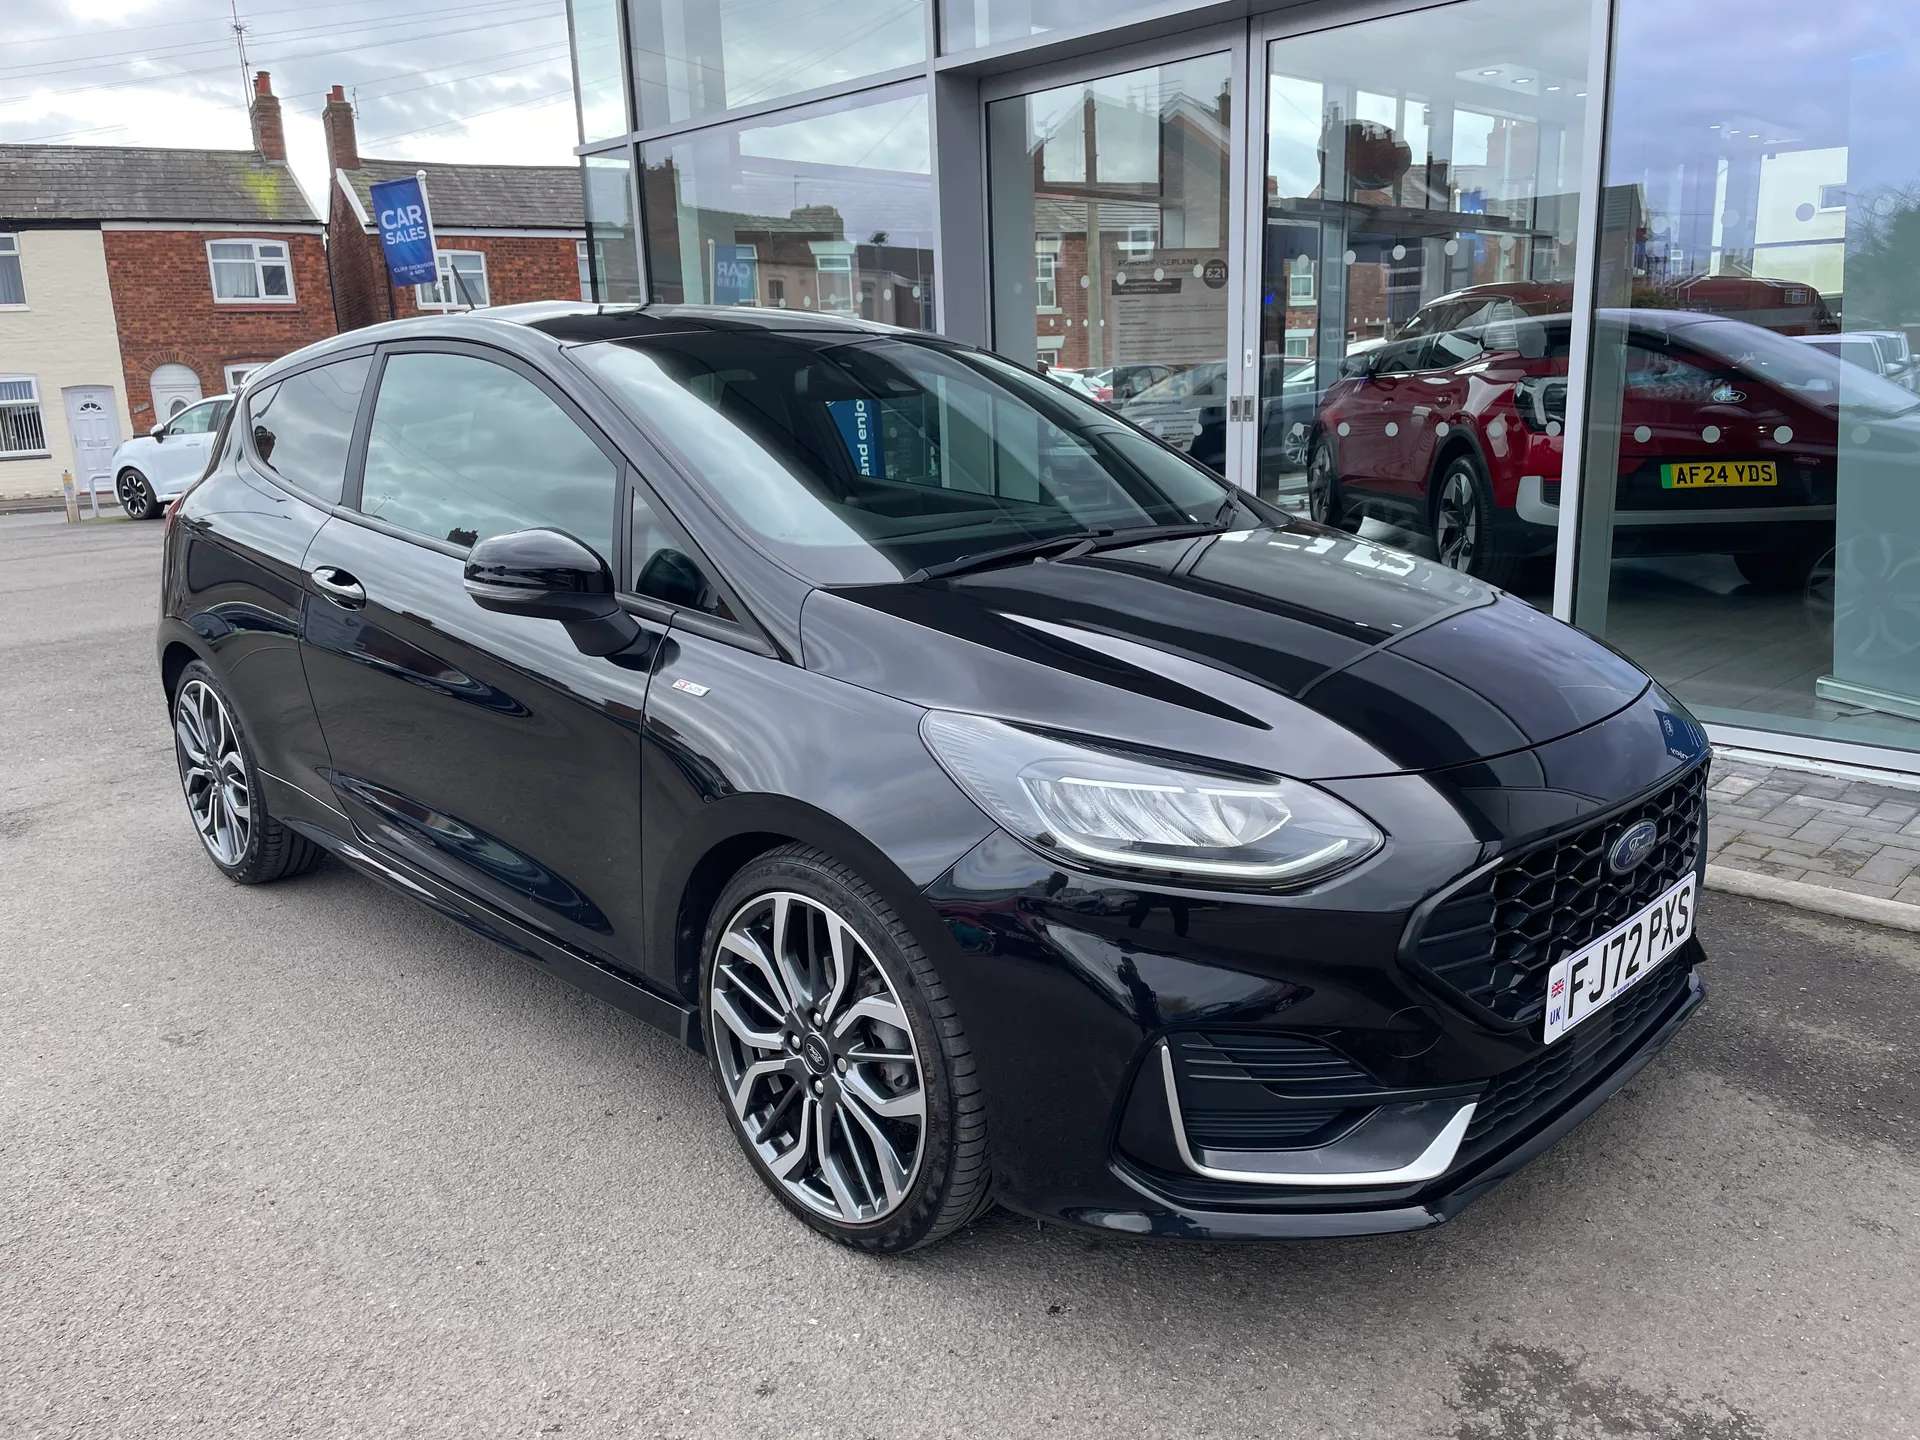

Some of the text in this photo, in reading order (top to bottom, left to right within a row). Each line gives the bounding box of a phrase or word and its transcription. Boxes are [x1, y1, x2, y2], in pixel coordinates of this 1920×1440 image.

[381, 205, 423, 230] CAR
[385, 227, 427, 245] SALES
[855, 399, 870, 476] and enjo
[1676, 464, 1773, 484] AF24 YDS
[1568, 887, 1690, 1019] FJ72 PXS
[1550, 1006, 1562, 1026] UK
